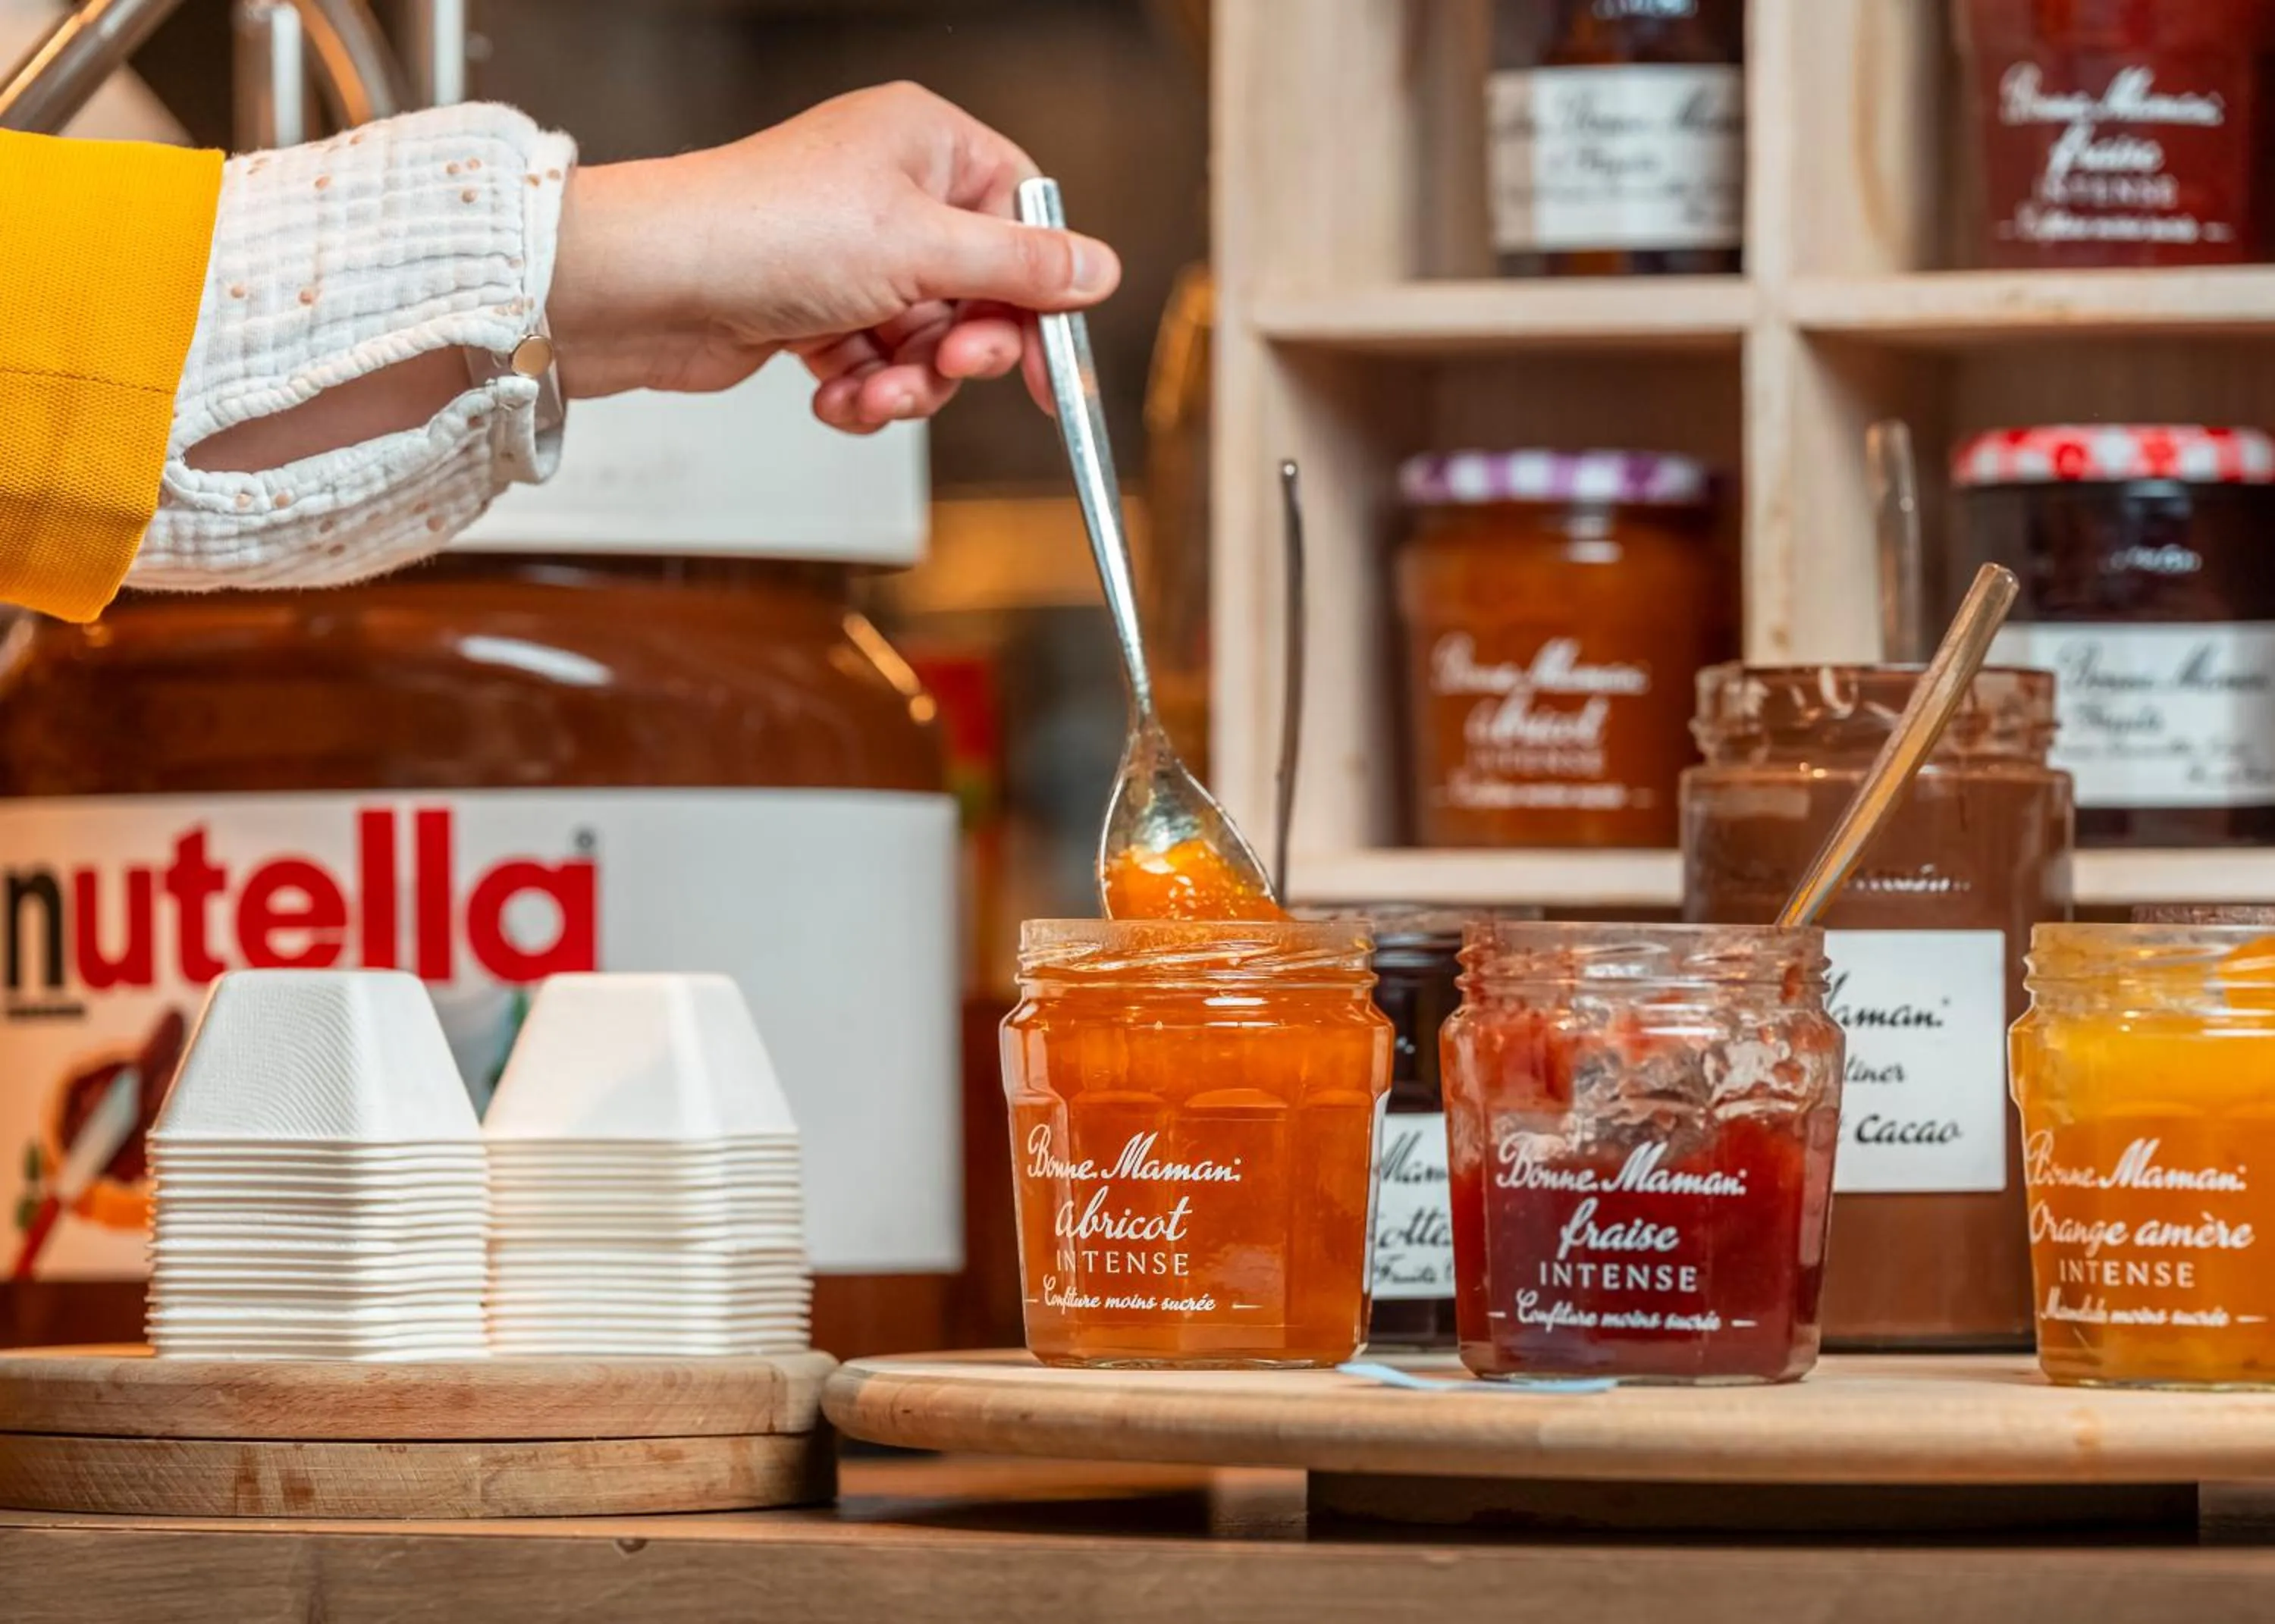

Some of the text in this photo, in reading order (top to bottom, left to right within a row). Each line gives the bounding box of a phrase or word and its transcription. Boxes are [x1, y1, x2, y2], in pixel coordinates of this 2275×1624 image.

[5, 805, 599, 990] nutella
[1854, 1113, 1964, 1145] Cacao
[1557, 1196, 1680, 1261] fraise
[2029, 1199, 2255, 1258] Orange amère
[1056, 1249, 1190, 1275] INTENSE
[1540, 1261, 1698, 1293] INTENSE
[2059, 1259, 2195, 1288] INTENSE
[1043, 1274, 1217, 1315] Confiture moins sucrée
[1517, 1288, 1598, 1333] Confiture
[1600, 1303, 1662, 1330] moins
